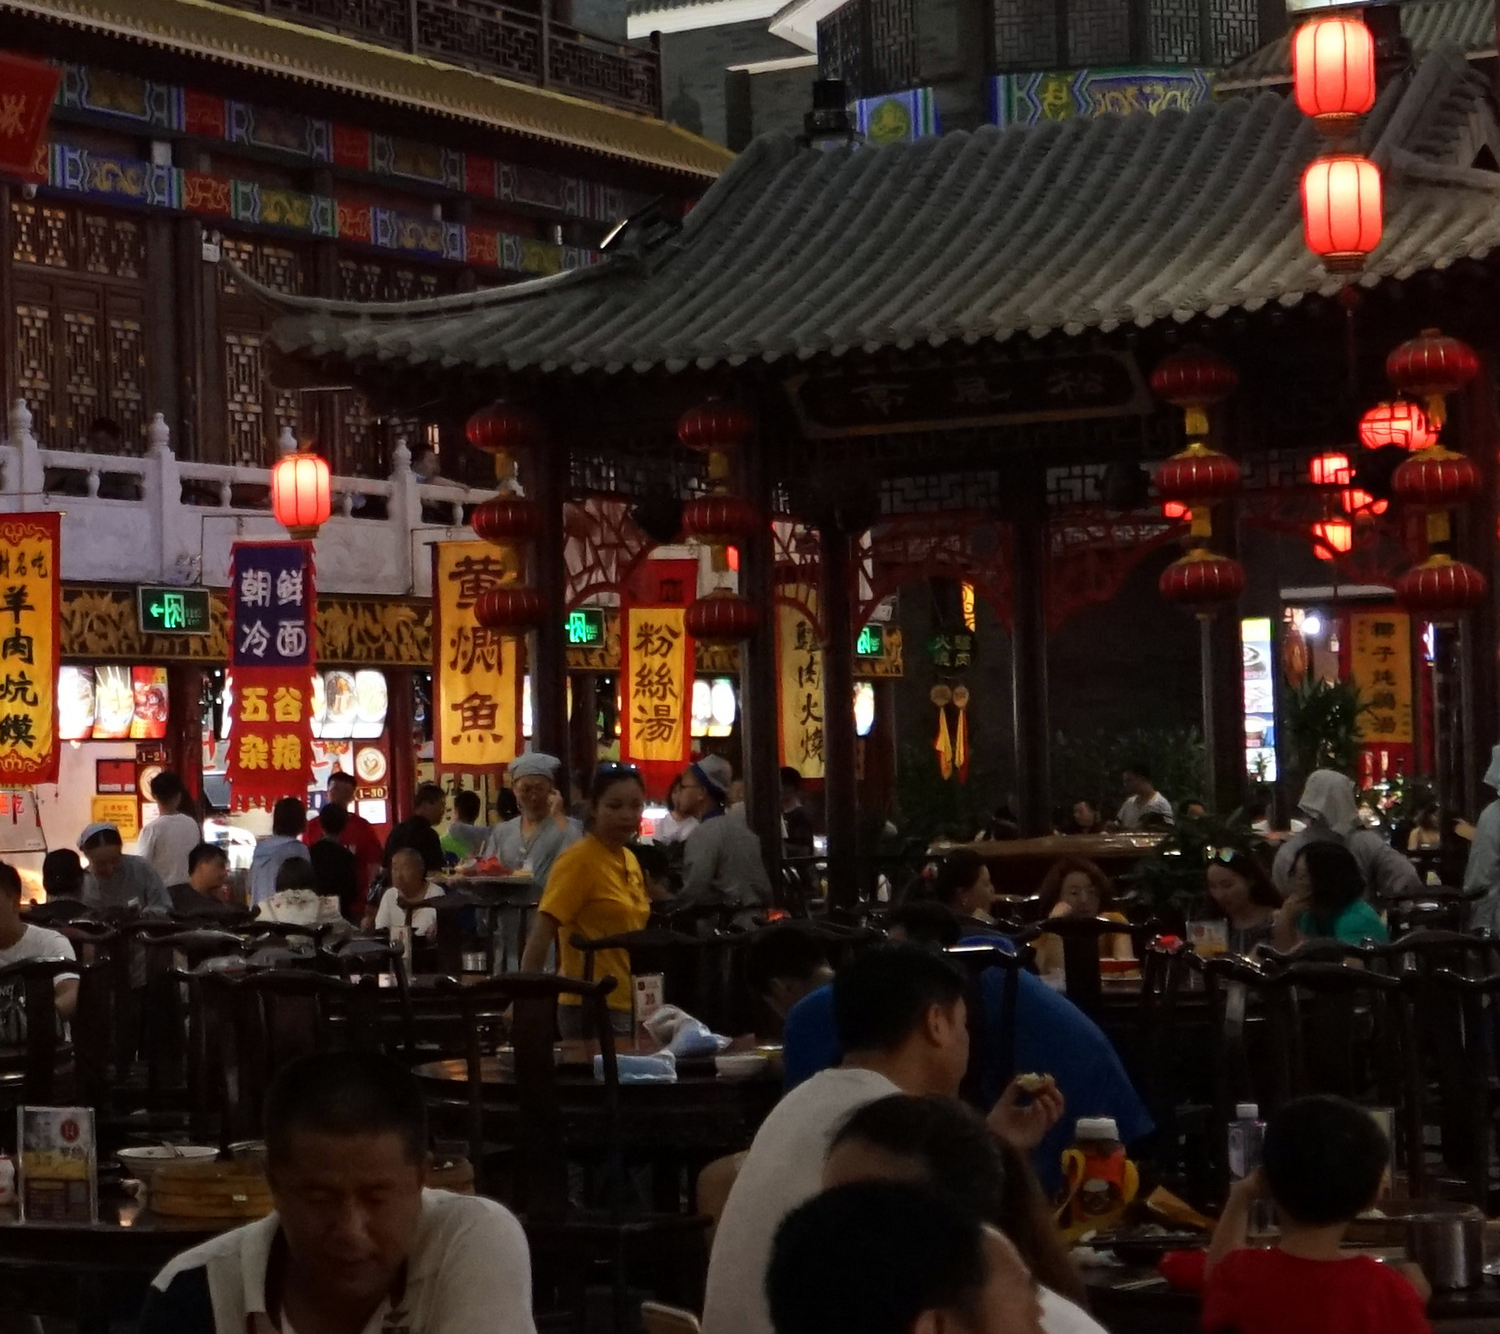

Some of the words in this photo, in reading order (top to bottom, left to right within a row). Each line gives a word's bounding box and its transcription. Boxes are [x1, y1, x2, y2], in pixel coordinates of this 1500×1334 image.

[240, 619, 307, 659] 冷面
[632, 621, 682, 743] 粉絲湯
[240, 687, 303, 723] 五谷
[239, 733, 302, 770] 杂粮
